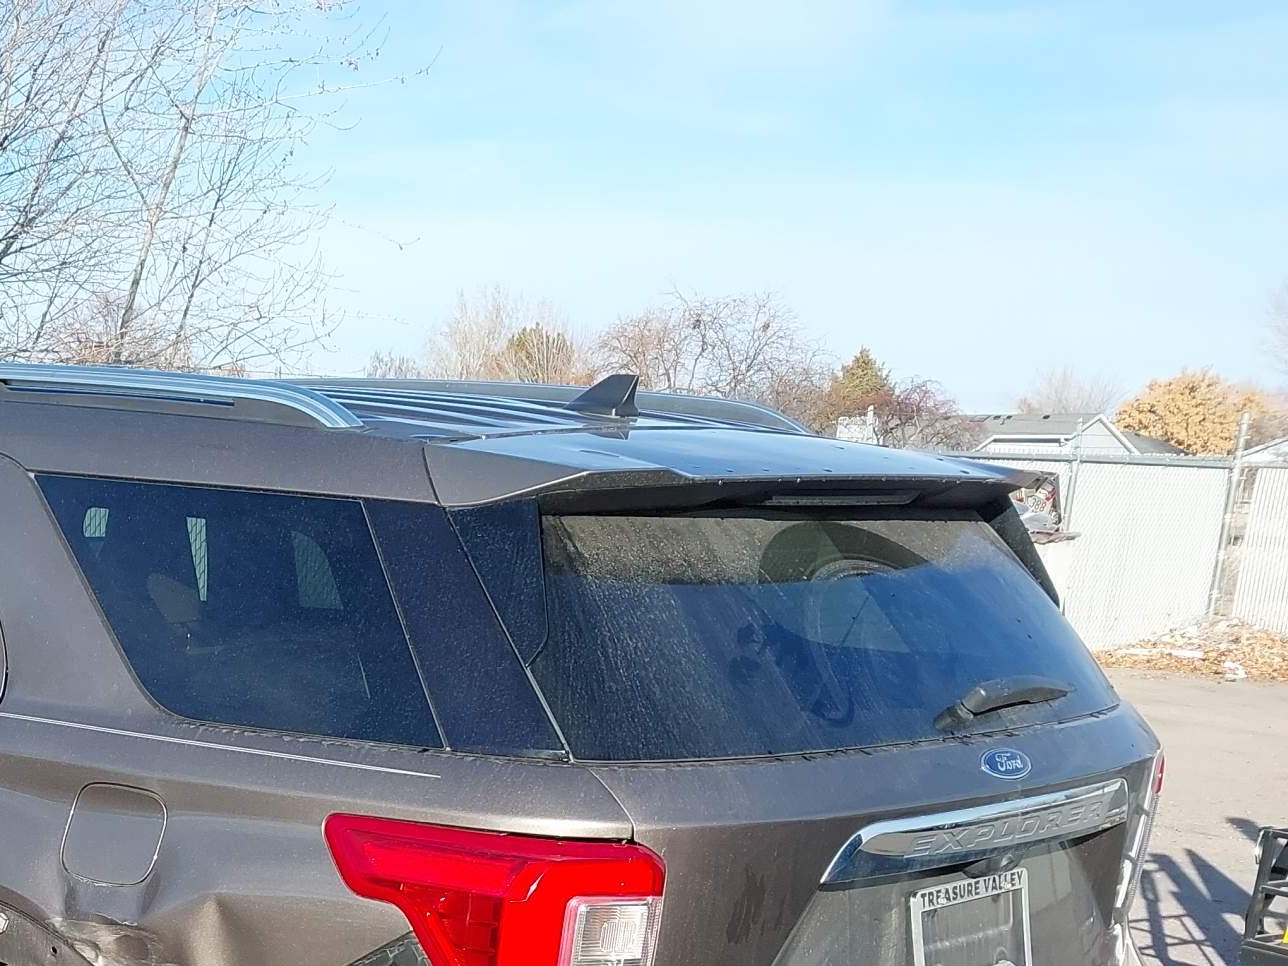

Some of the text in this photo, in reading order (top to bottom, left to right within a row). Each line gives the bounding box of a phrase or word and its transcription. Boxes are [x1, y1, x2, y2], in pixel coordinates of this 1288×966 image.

[995, 752, 1024, 771] Ford
[903, 802, 1106, 858] EXPLORER
[920, 870, 1024, 909] TREASURE VALLEY
